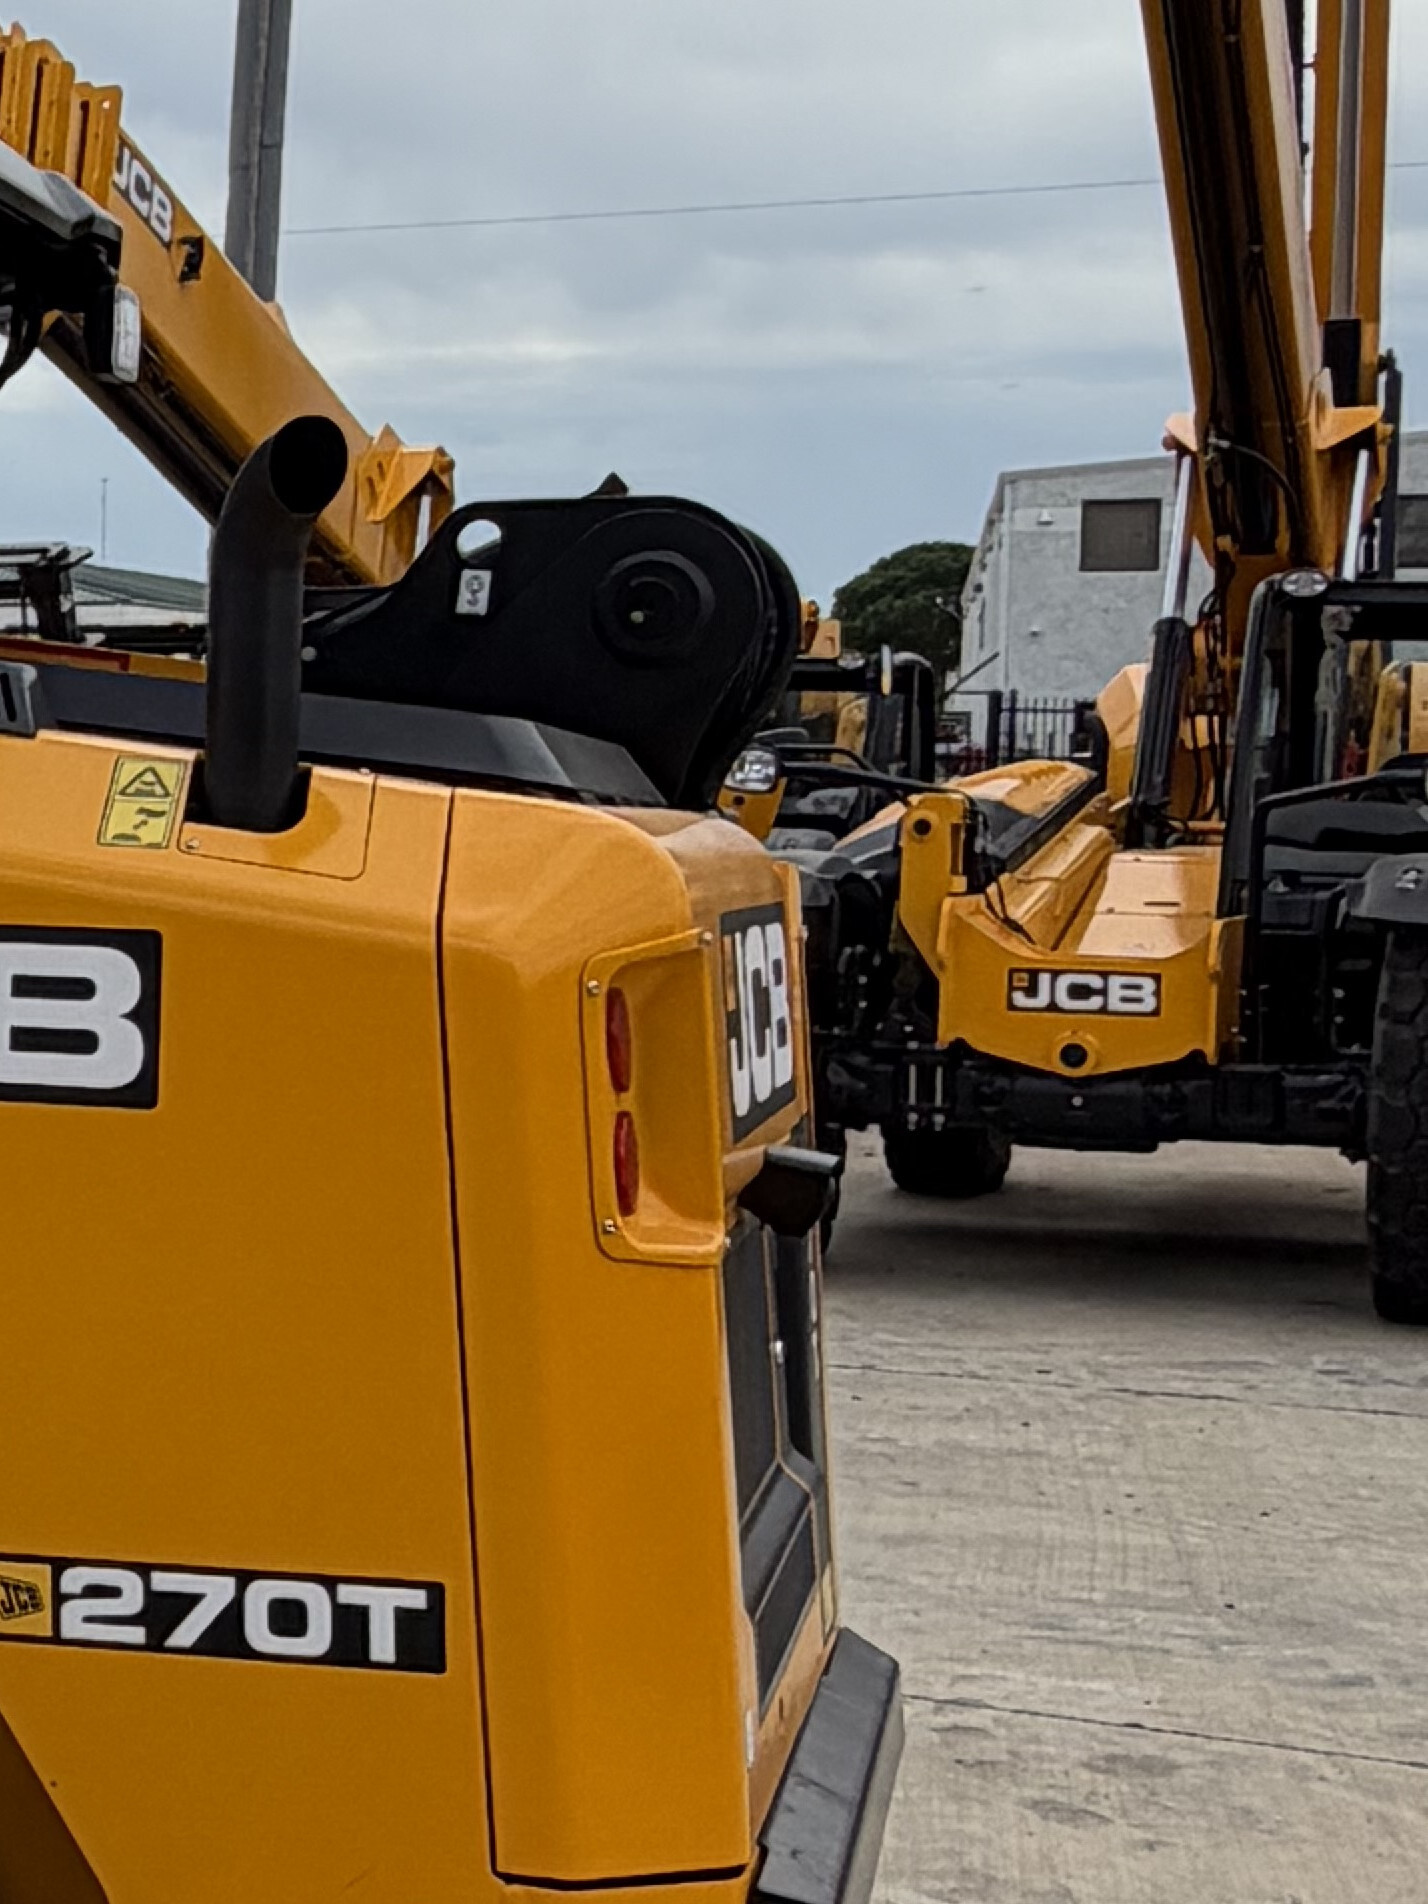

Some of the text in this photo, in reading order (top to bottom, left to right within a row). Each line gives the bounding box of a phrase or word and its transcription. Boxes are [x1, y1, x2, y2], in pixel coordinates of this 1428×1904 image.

[112, 146, 172, 244] JCB
[730, 922, 793, 1118] JCB
[1011, 971, 1158, 1014] JCB
[59, 1566, 429, 1664] 270T
